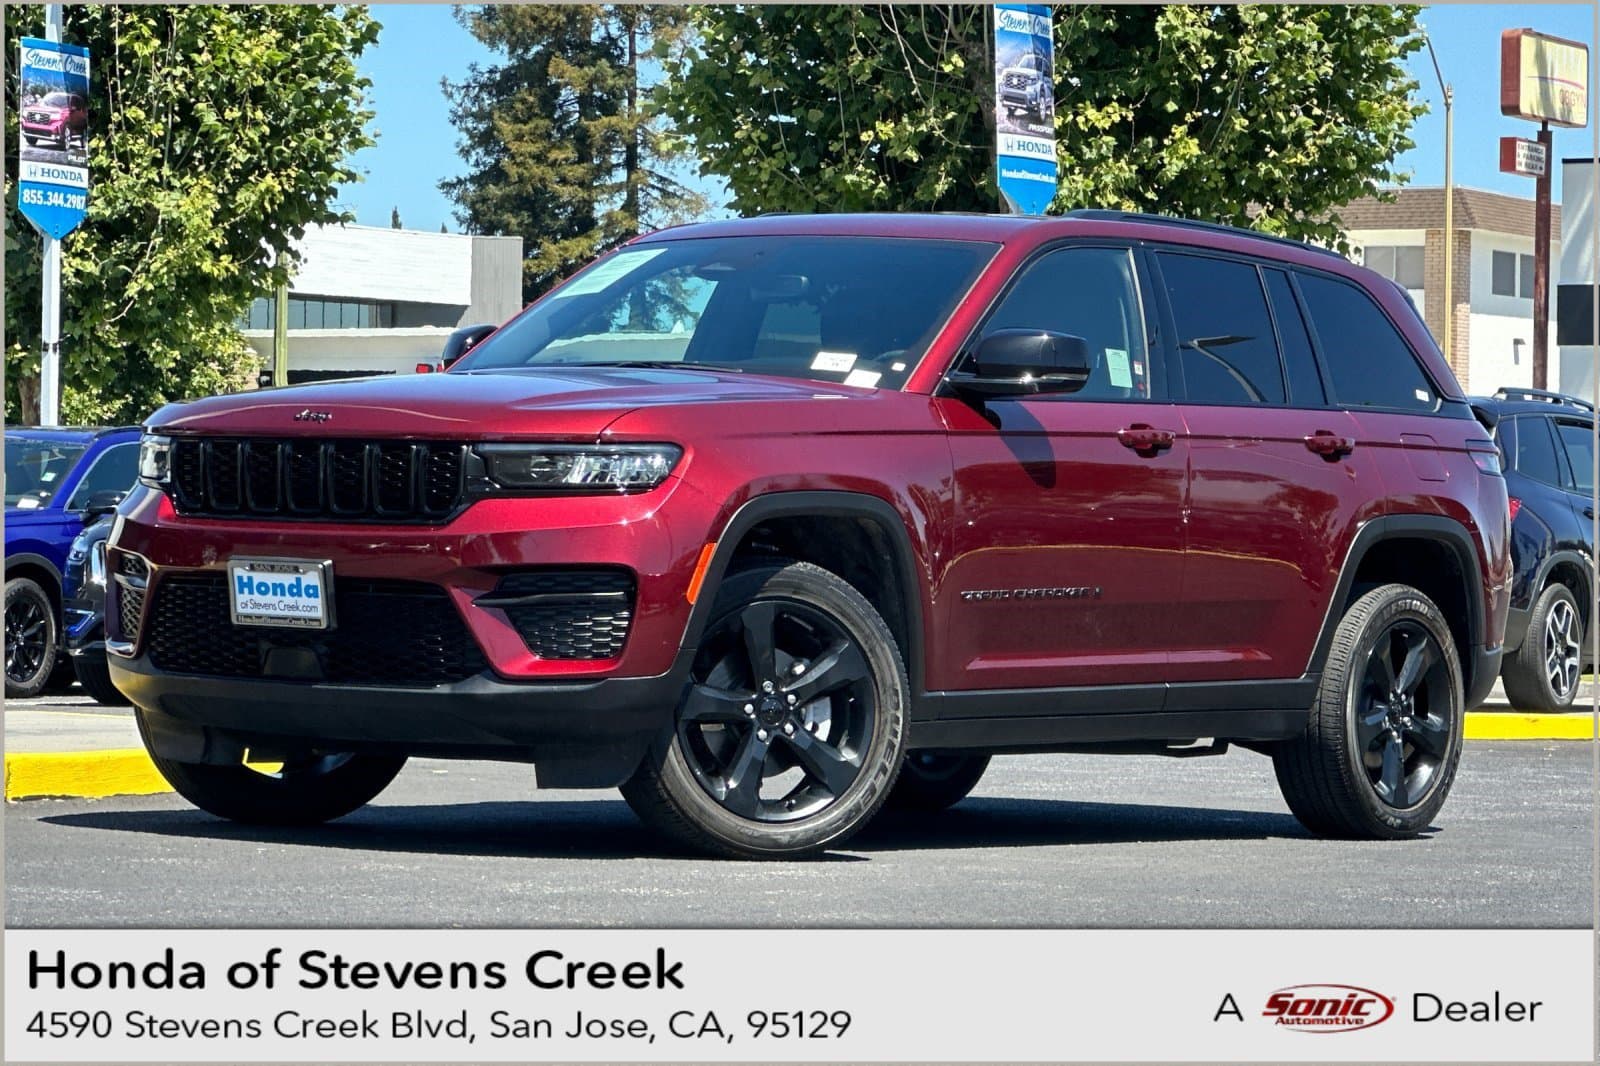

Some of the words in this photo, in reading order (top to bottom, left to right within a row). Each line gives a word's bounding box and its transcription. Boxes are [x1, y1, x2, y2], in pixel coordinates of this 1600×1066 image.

[1016, 140, 1053, 156] HONDA
[40, 167, 83, 183] HONDA
[236, 575, 320, 599] Honda
